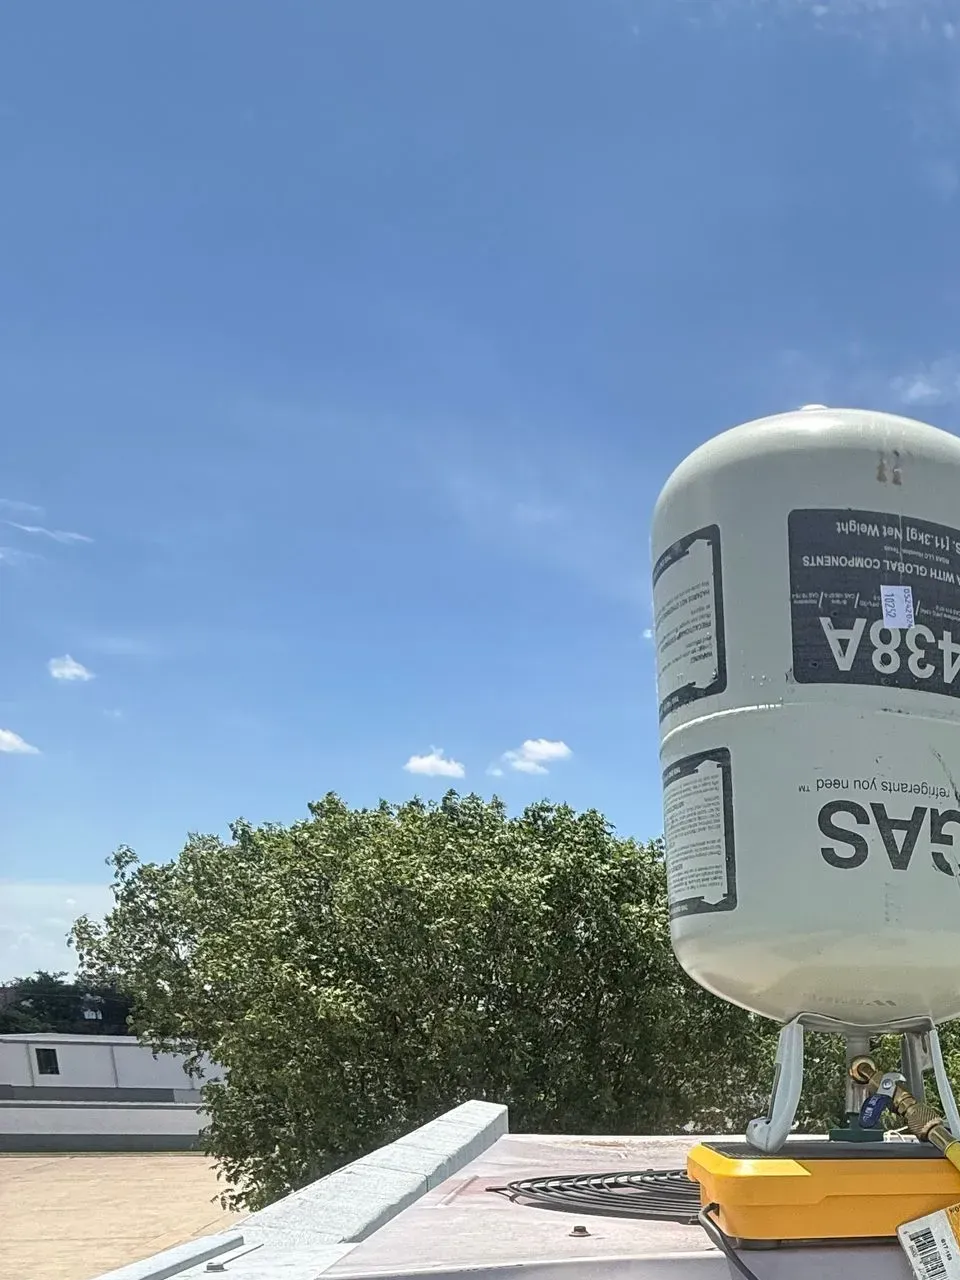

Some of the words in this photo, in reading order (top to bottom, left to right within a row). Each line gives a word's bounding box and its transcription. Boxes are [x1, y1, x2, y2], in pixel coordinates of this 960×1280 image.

[835, 520, 879, 537] Weight
[882, 526, 902, 539] Net
[906, 526, 950, 550] [11.3kg]
[802, 555, 880, 569] COMPONENTS
[883, 559, 927, 576] GLOBAL
[930, 567, 954, 583] WITH
[884, 592, 897, 619] 10252
[816, 778, 848, 793] need
[853, 777, 877, 792] you
[880, 780, 950, 799] refrigerants
